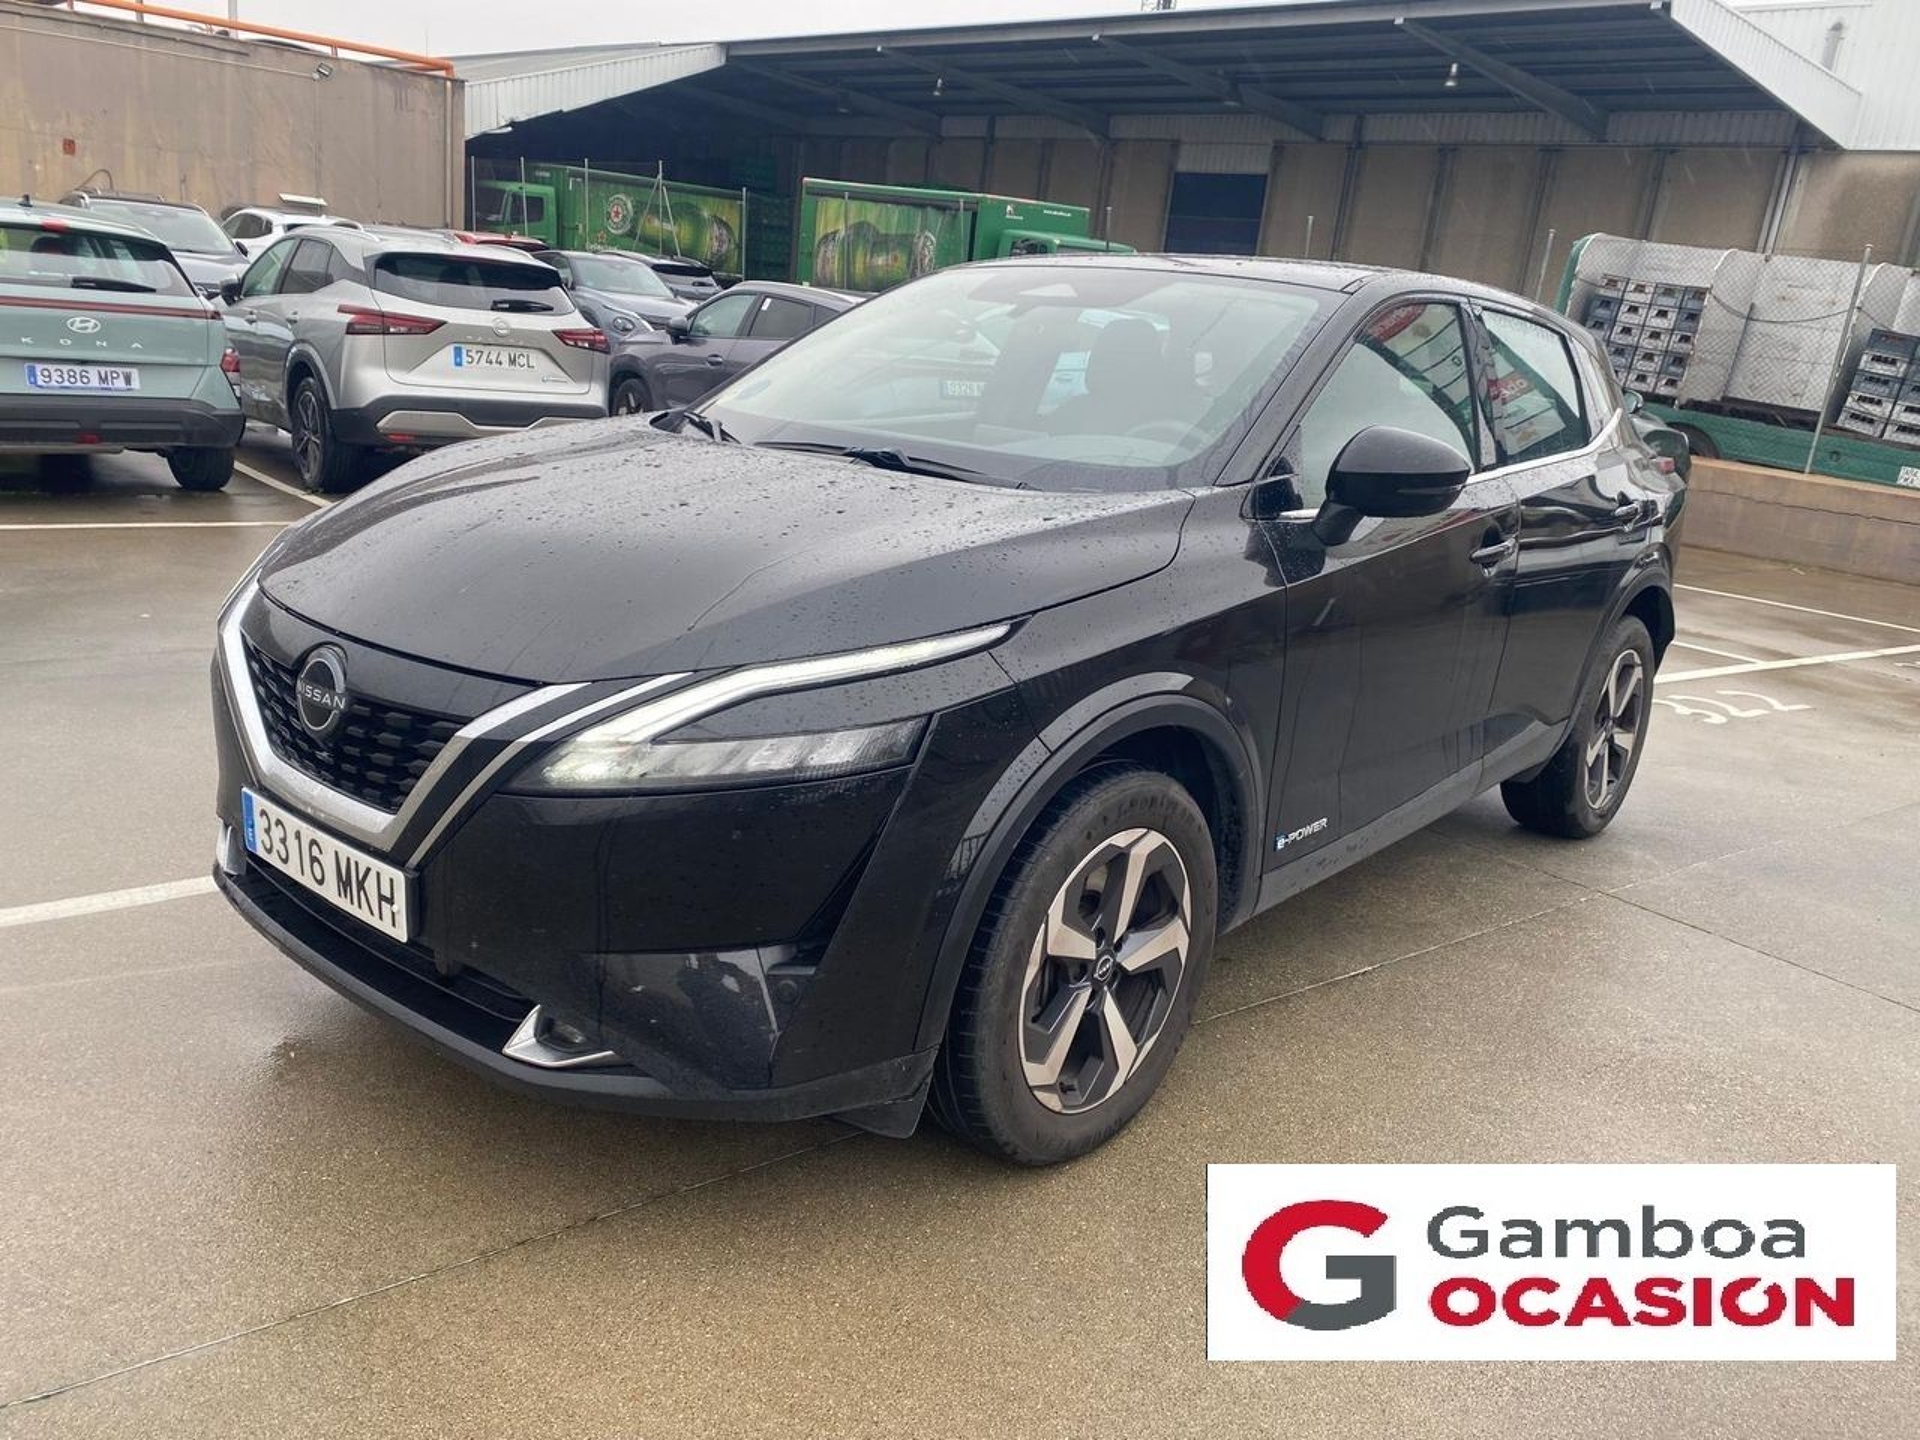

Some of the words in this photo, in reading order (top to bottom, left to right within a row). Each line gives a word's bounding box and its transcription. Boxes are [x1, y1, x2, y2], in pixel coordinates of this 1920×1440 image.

[20, 336, 144, 349] KONA
[465, 349, 504, 367] 5744
[508, 351, 536, 369] MCL
[40, 367, 91, 386] 9386
[97, 369, 133, 387] MPW
[1276, 817, 1329, 850] e-POWER
[259, 807, 326, 886] 3316
[334, 849, 397, 929] MKH
